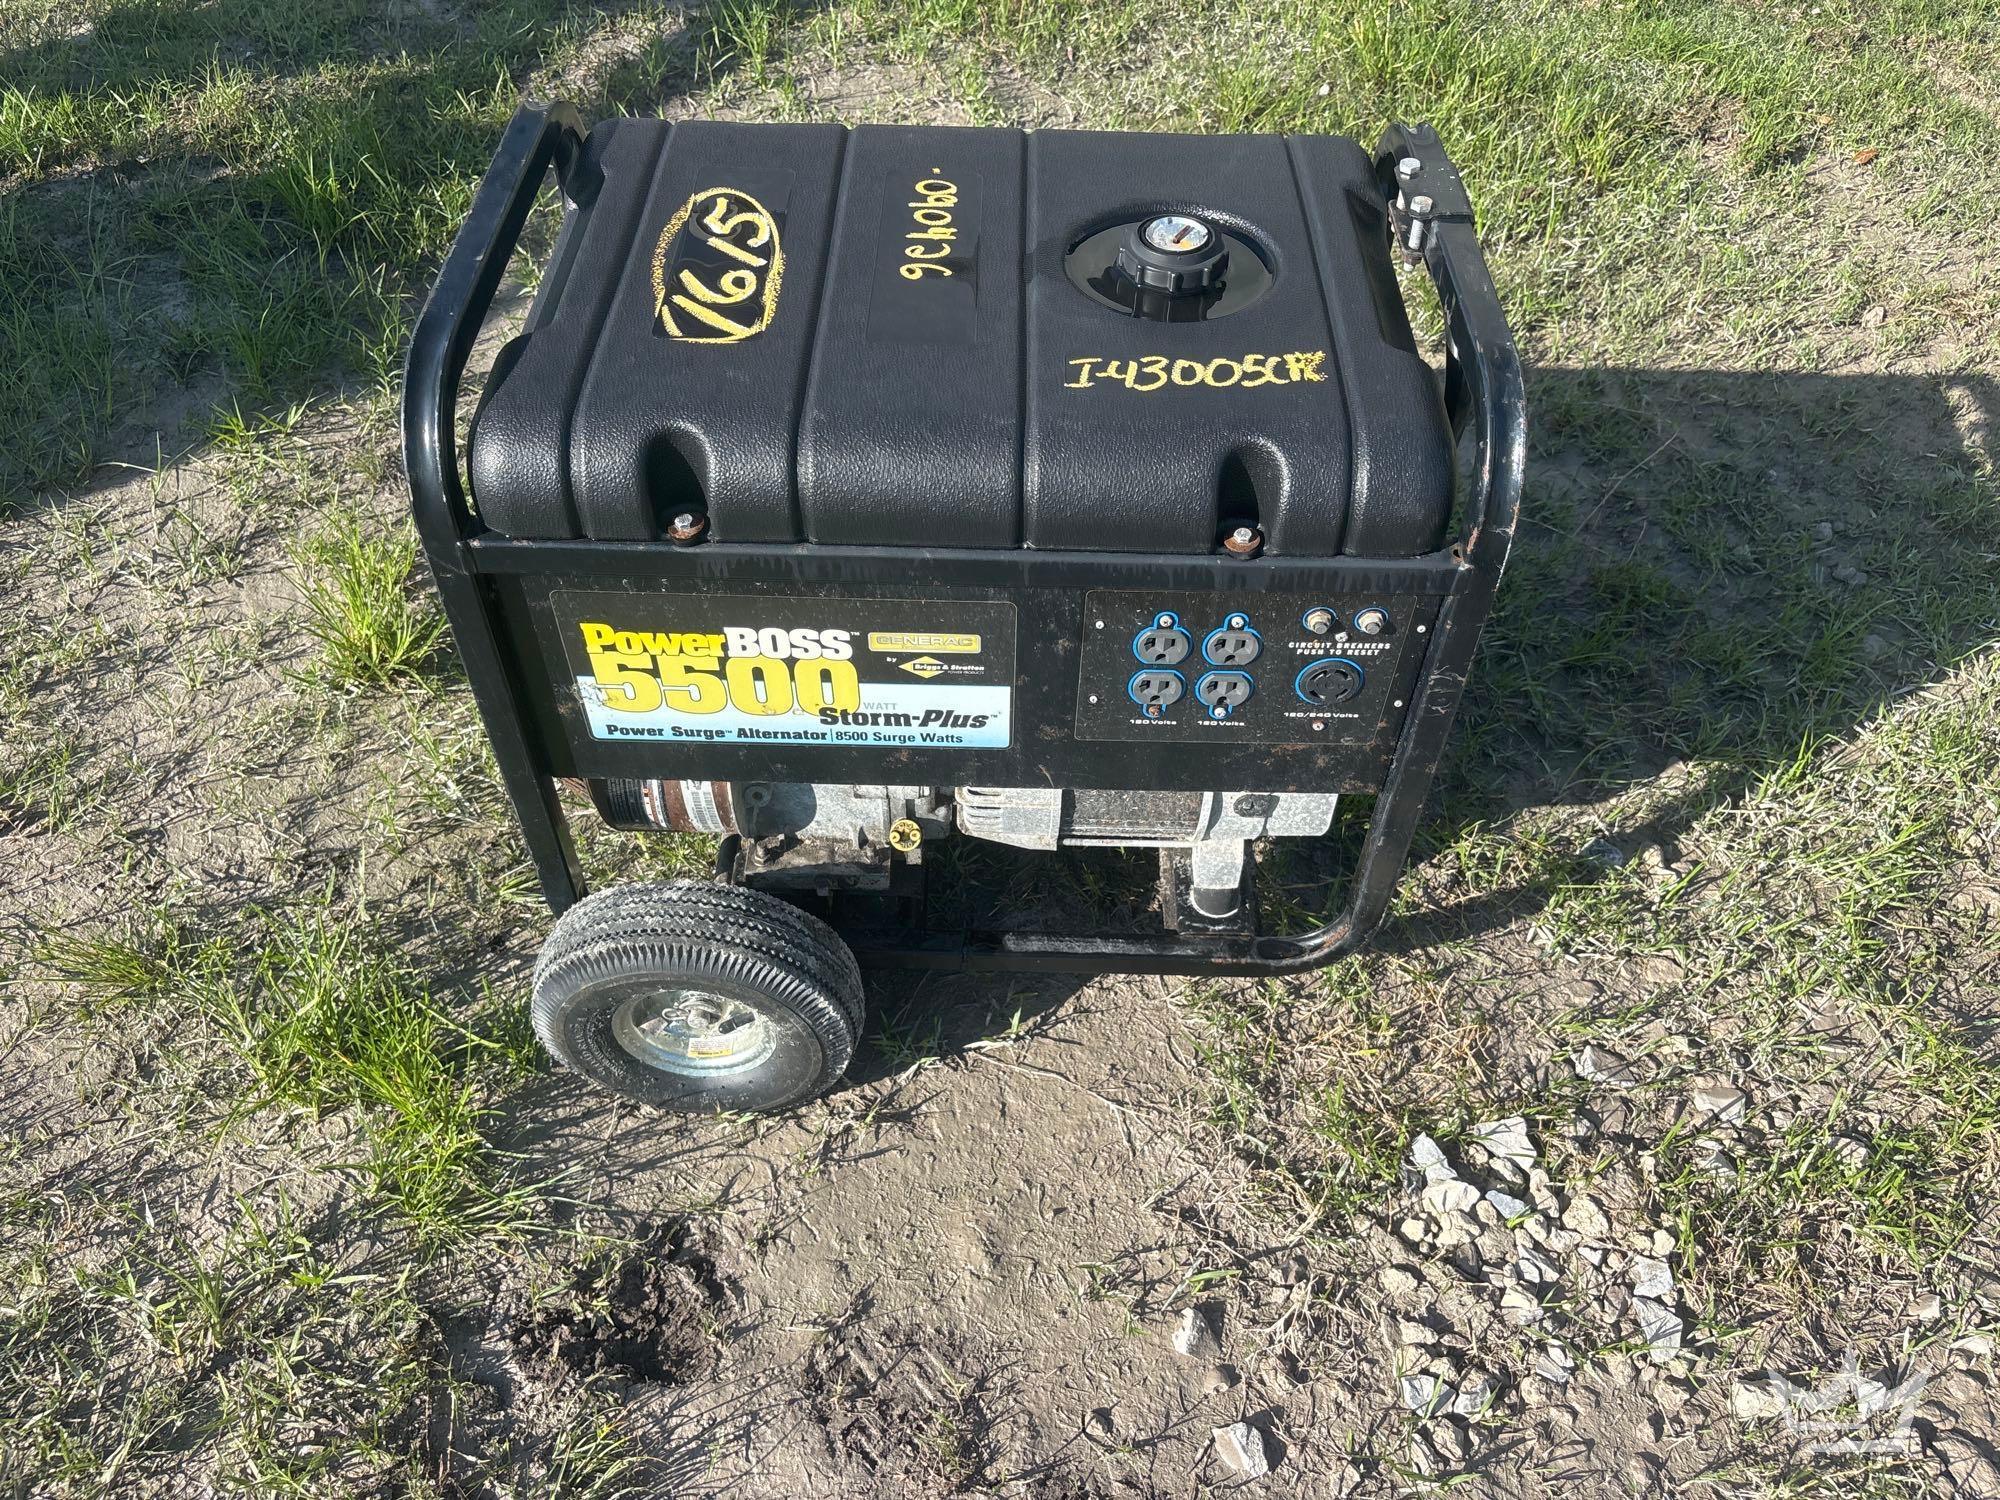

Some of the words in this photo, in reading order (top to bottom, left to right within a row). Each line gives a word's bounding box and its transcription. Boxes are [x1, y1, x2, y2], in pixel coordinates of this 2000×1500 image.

[661, 197, 771, 337] 1615
[876, 635, 973, 647] GENERAC
[1288, 641, 1332, 649] CIRCUIT
[914, 663, 941, 671] Briggs
[589, 651, 861, 716] 5500
[863, 702, 898, 710] WATT
[605, 724, 664, 737] Power
[736, 727, 827, 741] Alternator
[835, 731, 868, 741] 8500
[873, 731, 915, 744] Surge
[919, 732, 963, 743] Watts
